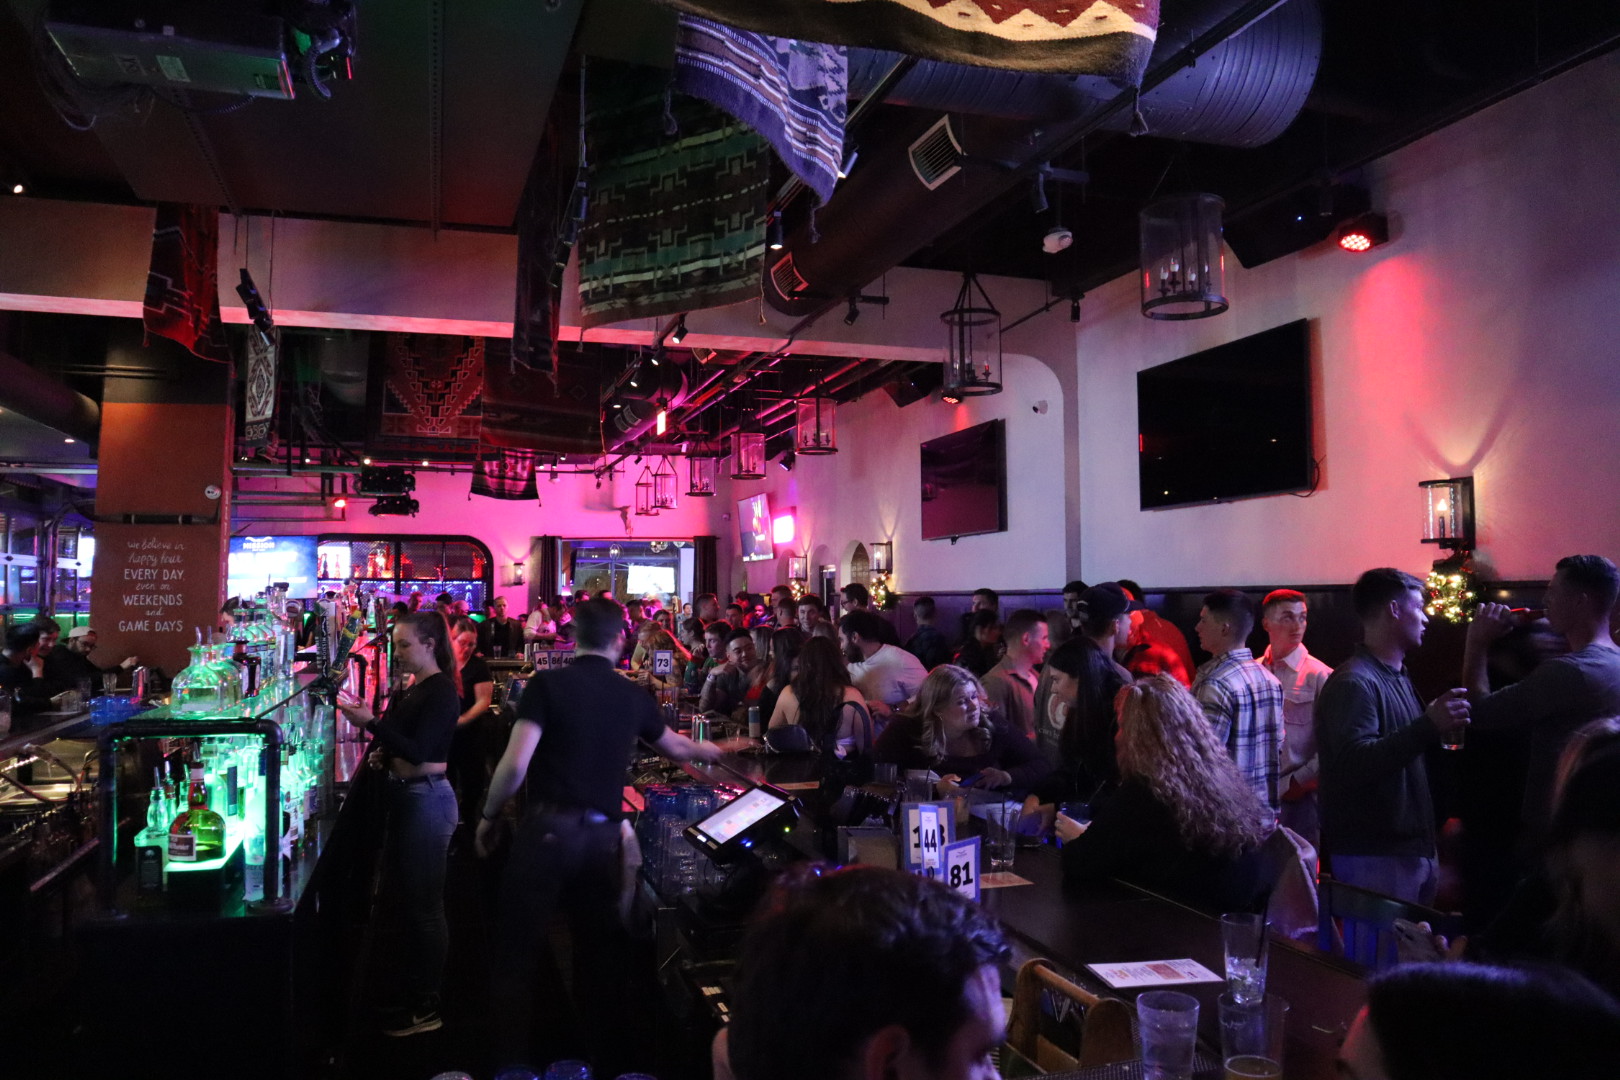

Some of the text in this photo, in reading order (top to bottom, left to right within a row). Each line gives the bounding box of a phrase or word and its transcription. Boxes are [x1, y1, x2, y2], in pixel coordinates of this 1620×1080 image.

[127, 537, 185, 550] we believe in
[128, 552, 183, 566] happy hour
[124, 568, 158, 580] EVERY
[122, 594, 183, 606] WEEKENDS
[146, 607, 164, 616] and
[118, 620, 183, 632] GAME DAYS
[537, 657, 548, 665] 45
[551, 656, 561, 664] 86
[657, 658, 669, 667] 73
[924, 829, 937, 852] 44
[950, 861, 973, 888] 81
